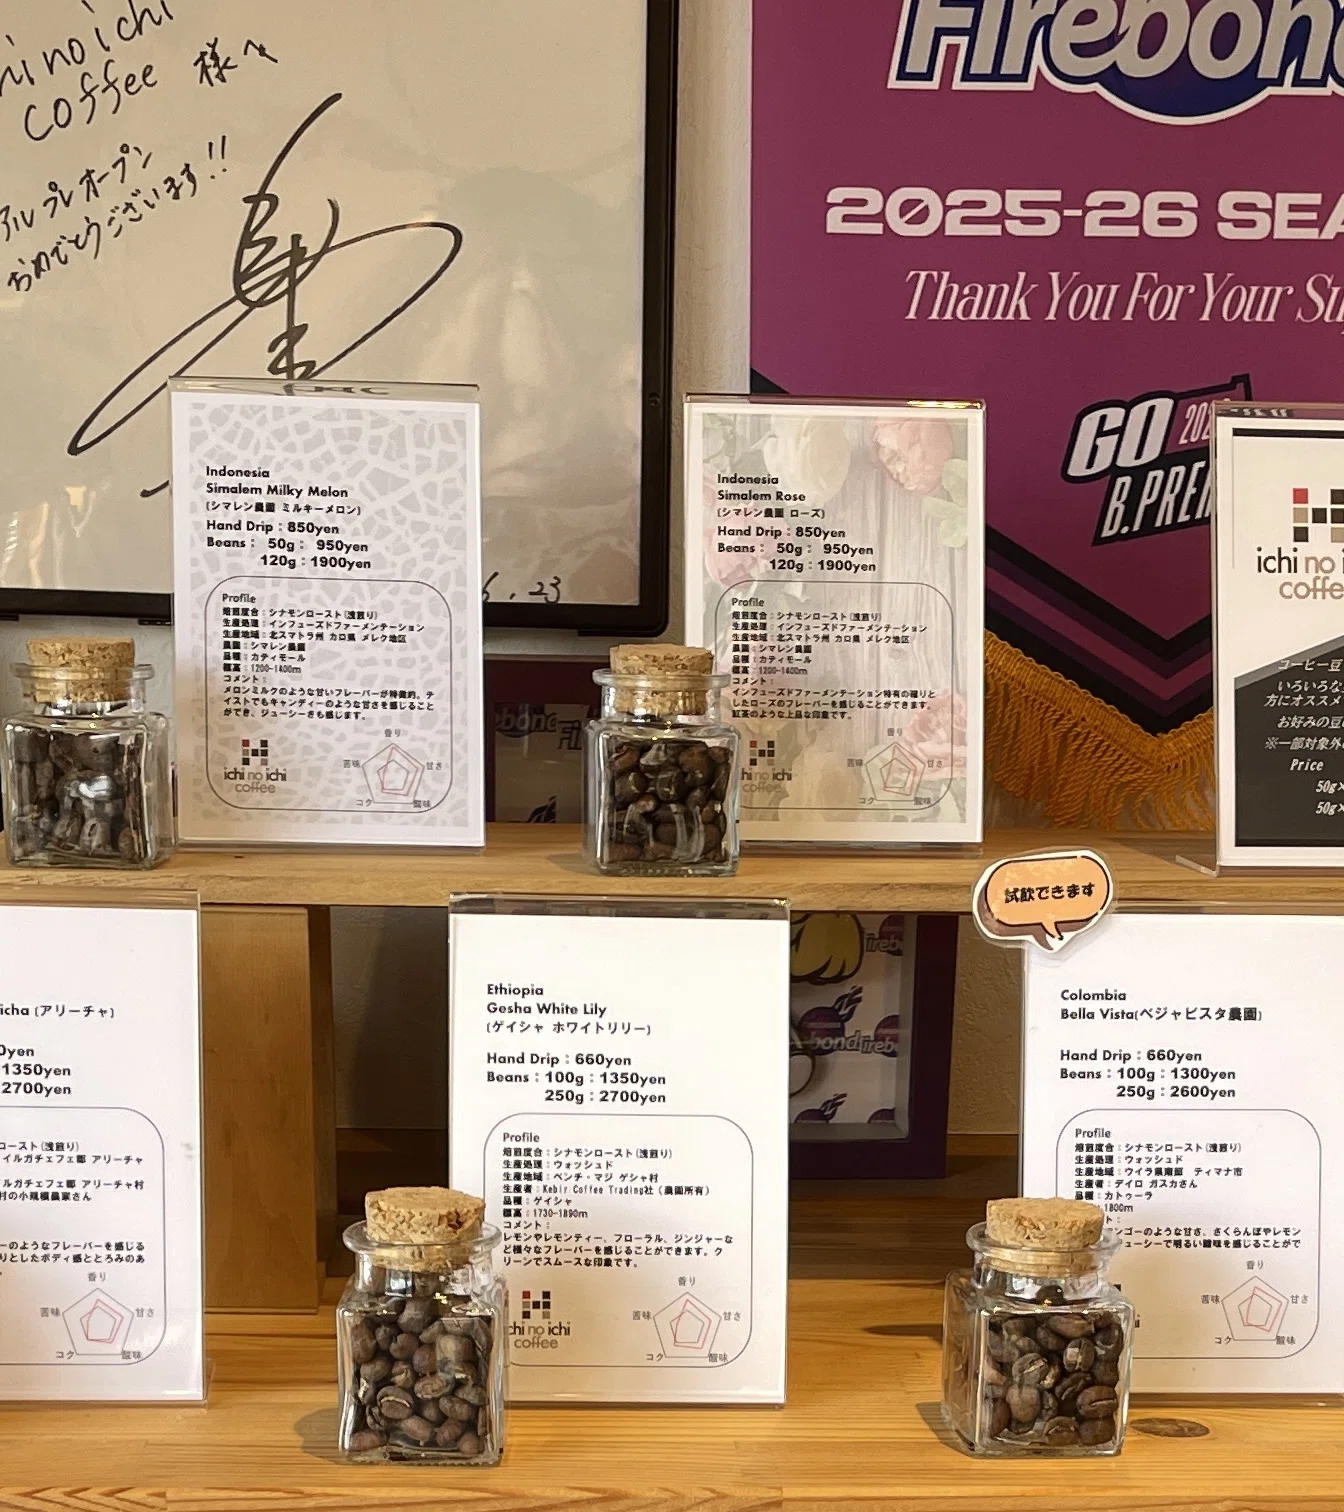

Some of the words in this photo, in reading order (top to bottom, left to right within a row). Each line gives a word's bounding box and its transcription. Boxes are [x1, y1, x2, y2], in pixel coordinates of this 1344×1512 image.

[826, 186, 1198, 236] 2025-26
[906, 270, 1039, 321] Thank
[1048, 274, 1119, 322] You
[1123, 276, 1195, 322] For
[1198, 277, 1294, 323] Your
[1066, 397, 1175, 477] GO
[206, 466, 270, 478] Indonesia
[718, 474, 779, 484] Indonesia
[206, 483, 262, 495] Simalem
[267, 484, 303, 499] Milky
[308, 486, 348, 497] Melon
[718, 490, 772, 502] Simalem
[776, 490, 806, 502] Rose
[1257, 547, 1298, 574] ichi
[1305, 556, 1335, 575] no
[222, 593, 256, 603] Profile
[1290, 759, 1323, 771] Price
[1004, 883, 1095, 903] 試飲できます
[487, 983, 544, 997] Ethiopia
[1061, 990, 1126, 1001] Colombia
[35, 1004, 115, 1018] (アリーチャ)
[487, 1002, 531, 1014] Gesha
[537, 1003, 578, 1015] White
[584, 1003, 607, 1017] Lily
[1061, 1008, 1095, 1020] Bella
[503, 1132, 539, 1143] Profile
